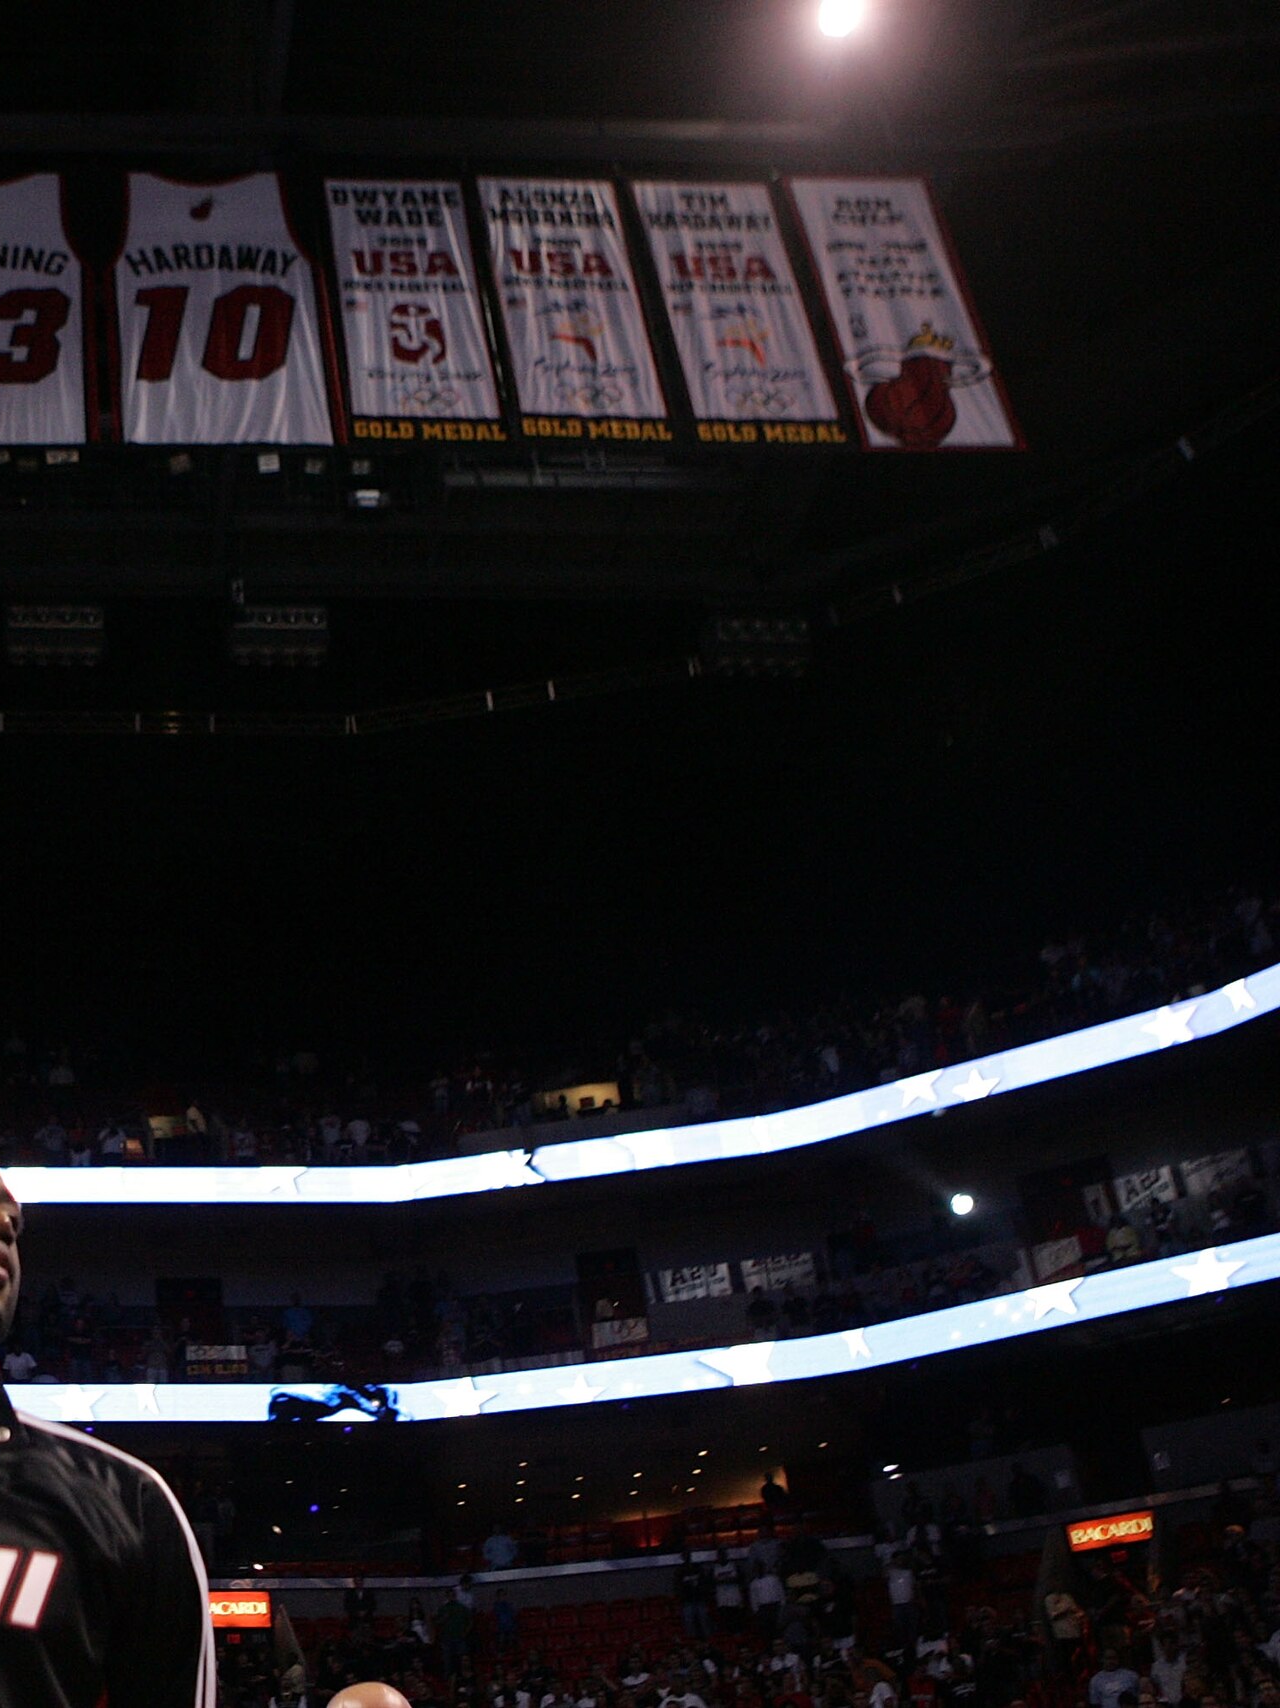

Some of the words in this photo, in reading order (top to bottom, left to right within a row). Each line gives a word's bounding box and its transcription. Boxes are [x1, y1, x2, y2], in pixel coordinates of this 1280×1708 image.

[331, 189, 459, 206] DWYANE
[680, 191, 729, 209] TIM
[355, 208, 444, 226] WADE
[124, 243, 298, 276] HARDAWAY
[352, 251, 459, 276] USA
[510, 250, 613, 276] USA
[671, 254, 778, 280] USA
[135, 285, 295, 383] 10
[352, 419, 417, 440] GOLD
[421, 421, 510, 443] MEDAL
[521, 415, 584, 438] GOLD
[587, 418, 674, 442] MEDAL
[696, 420, 760, 443] GOLD
[761, 422, 849, 445] MEDAL
[1070, 1516, 1154, 1545] BACARDI
[209, 1601, 268, 1615] ACARDI
